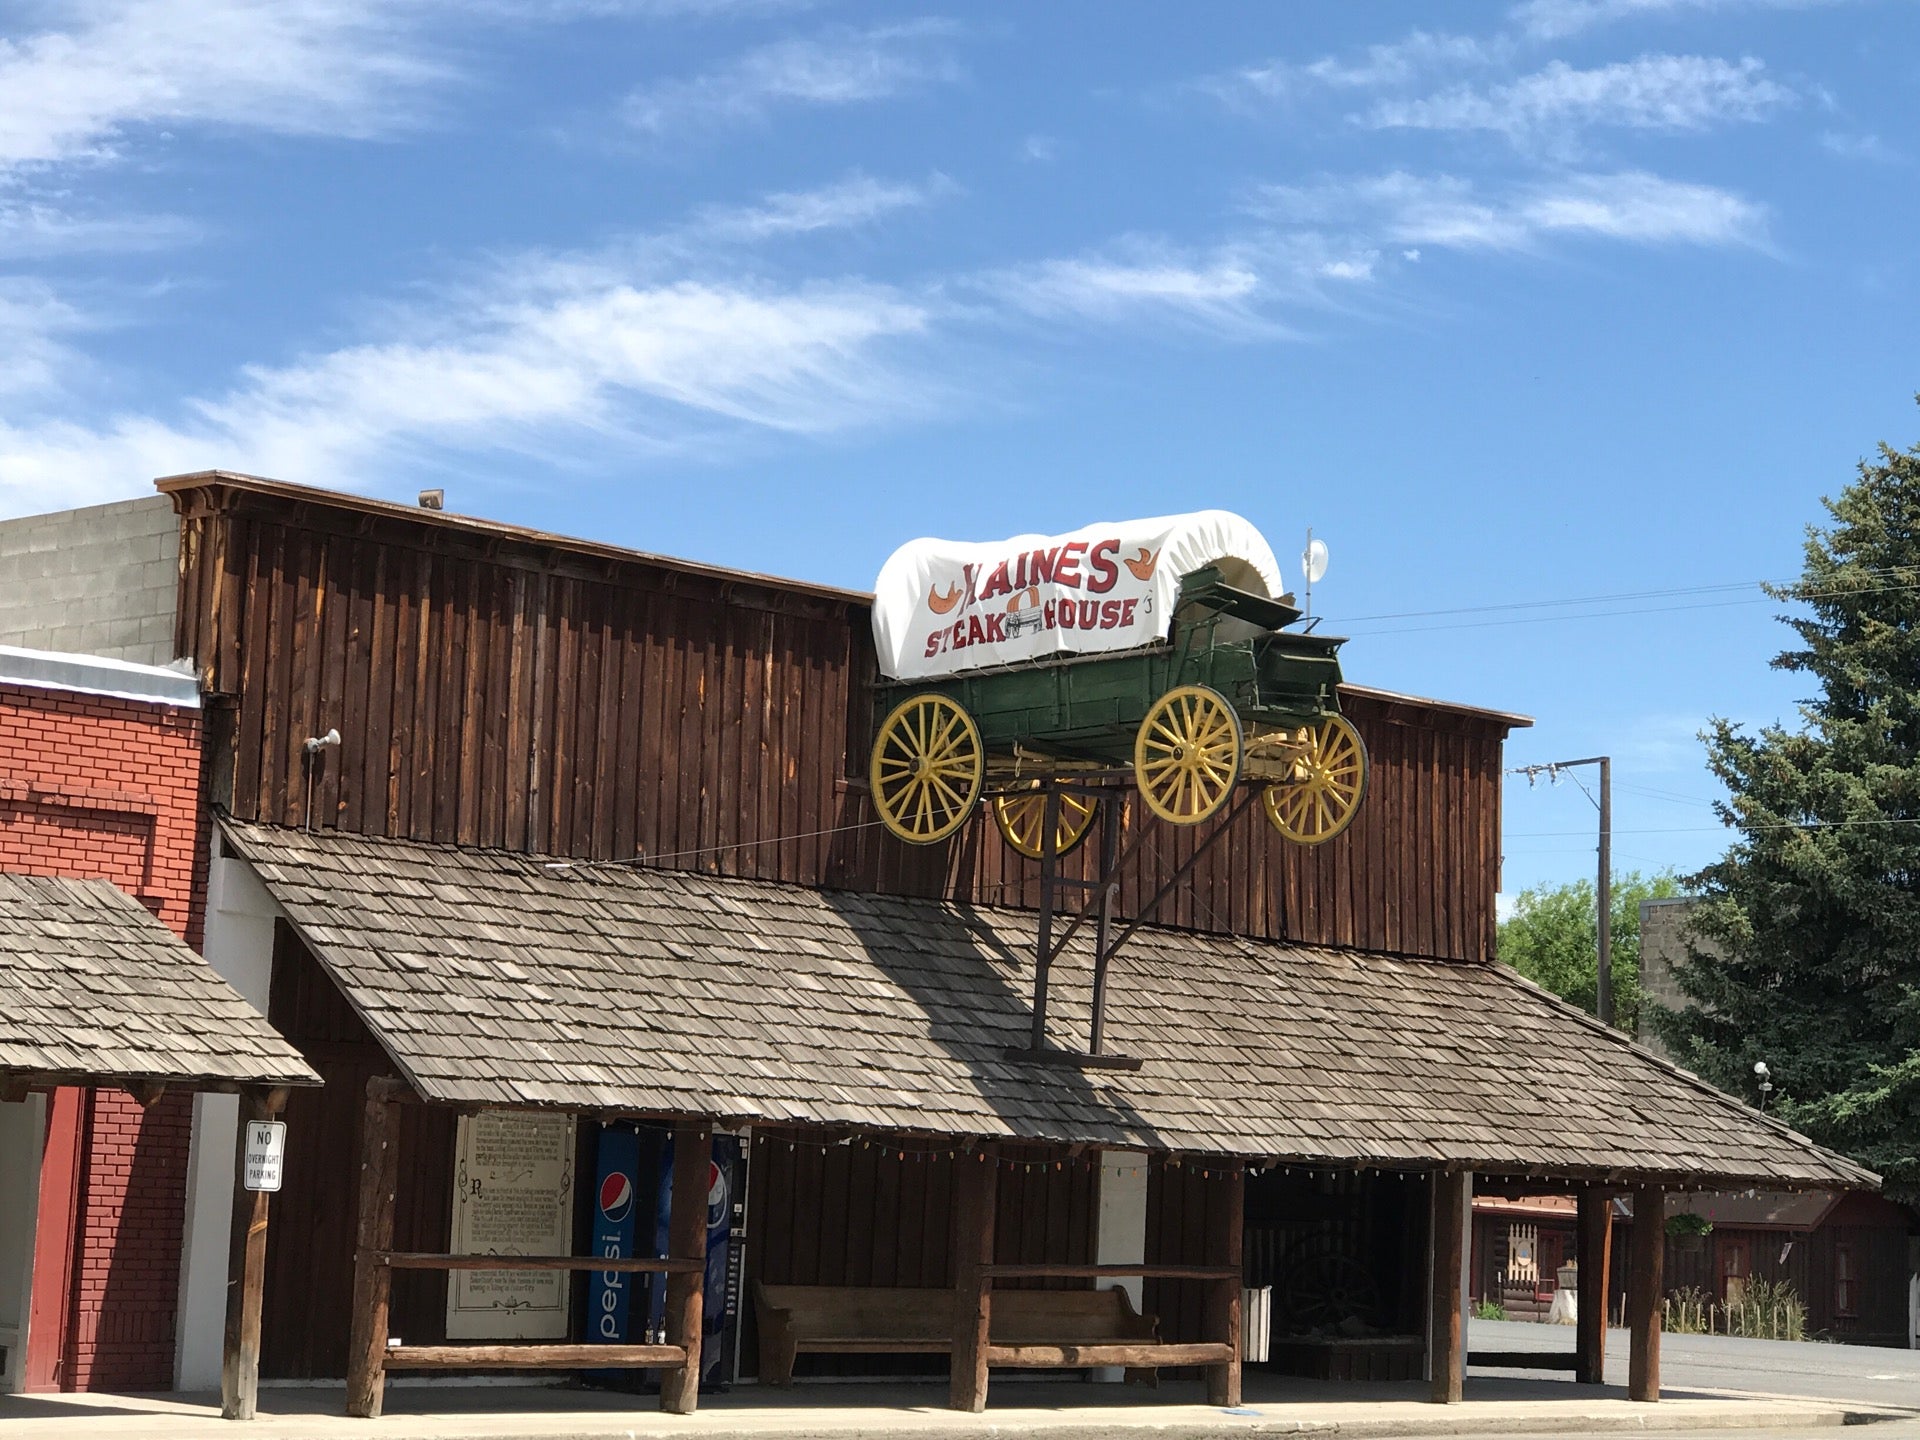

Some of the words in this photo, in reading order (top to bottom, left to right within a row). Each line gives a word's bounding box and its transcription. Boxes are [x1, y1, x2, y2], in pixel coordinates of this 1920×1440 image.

[924, 612, 1007, 658] STEAK
[1043, 598, 1139, 631] HOUSE
[256, 1131, 272, 1145] NO
[248, 1153, 280, 1165] OVERNIGHT
[249, 1169, 276, 1180] PARKING
